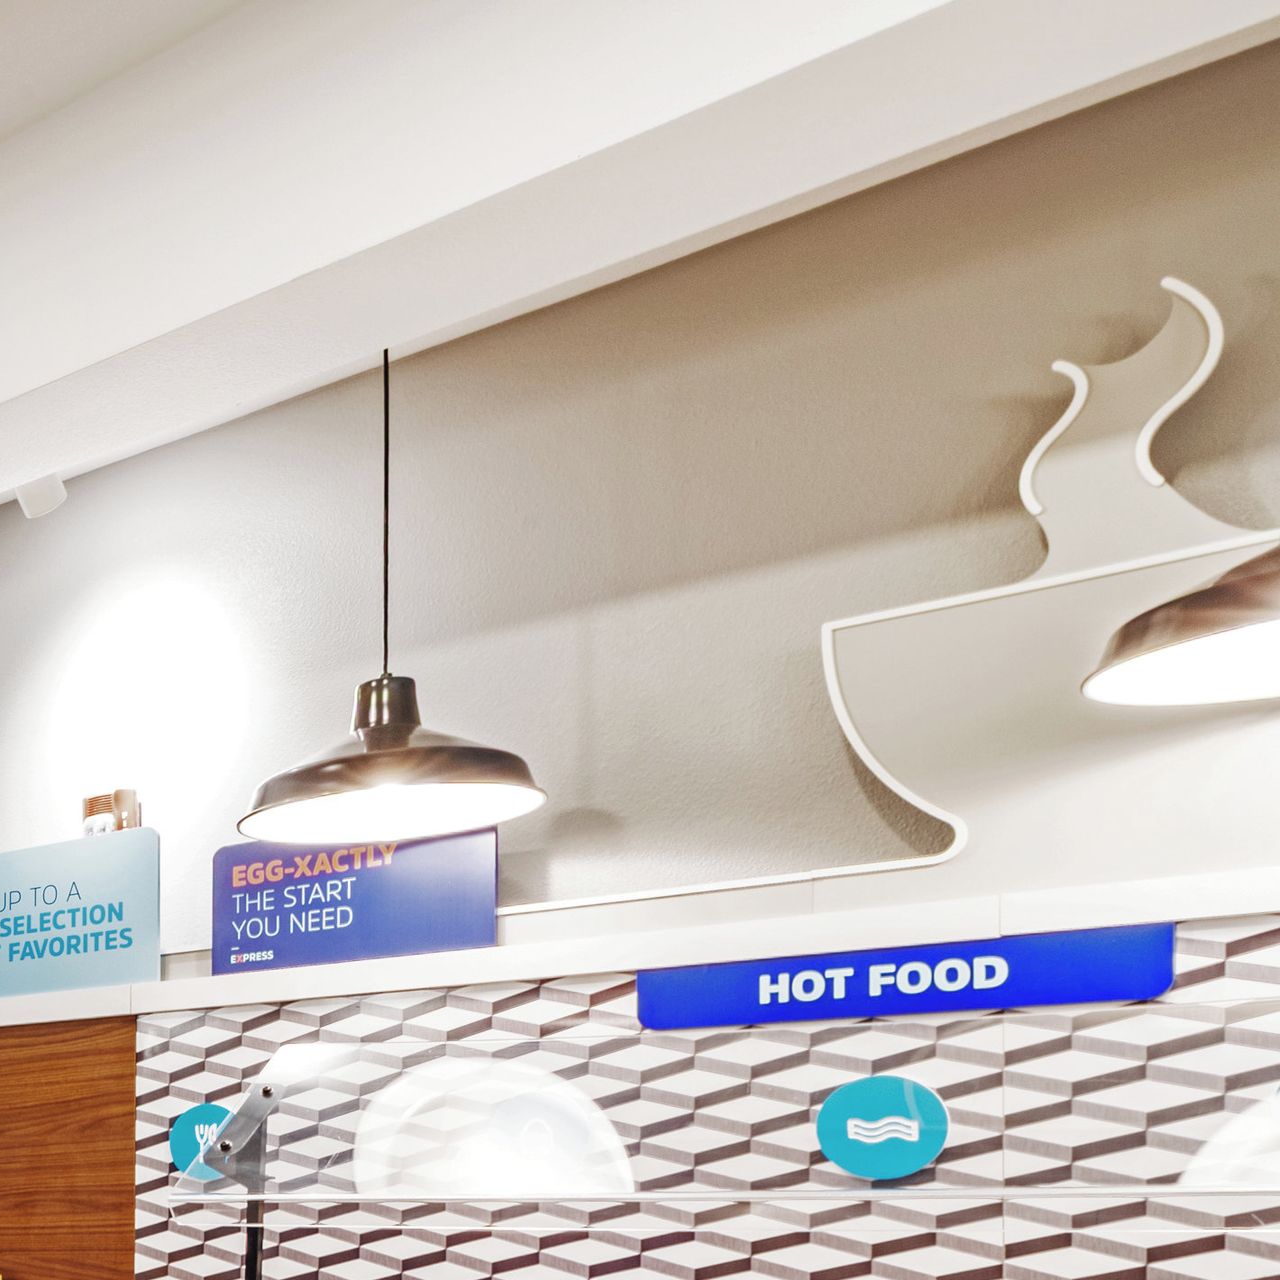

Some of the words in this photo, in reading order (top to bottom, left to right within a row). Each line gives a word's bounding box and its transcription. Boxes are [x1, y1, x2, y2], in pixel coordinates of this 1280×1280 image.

[232, 843, 397, 887] EGG-XACTLY
[30, 884, 58, 907] TO
[66, 881, 82, 902] A
[231, 889, 275, 914] THE
[283, 877, 356, 908] START
[0, 901, 124, 938] SELECTION
[231, 915, 280, 940] YOU
[290, 906, 353, 934] NEED
[8, 928, 133, 963] FAVORITES
[230, 950, 274, 964] EXPRESS
[758, 967, 854, 1005] HOT
[868, 955, 1009, 997] FOOD
